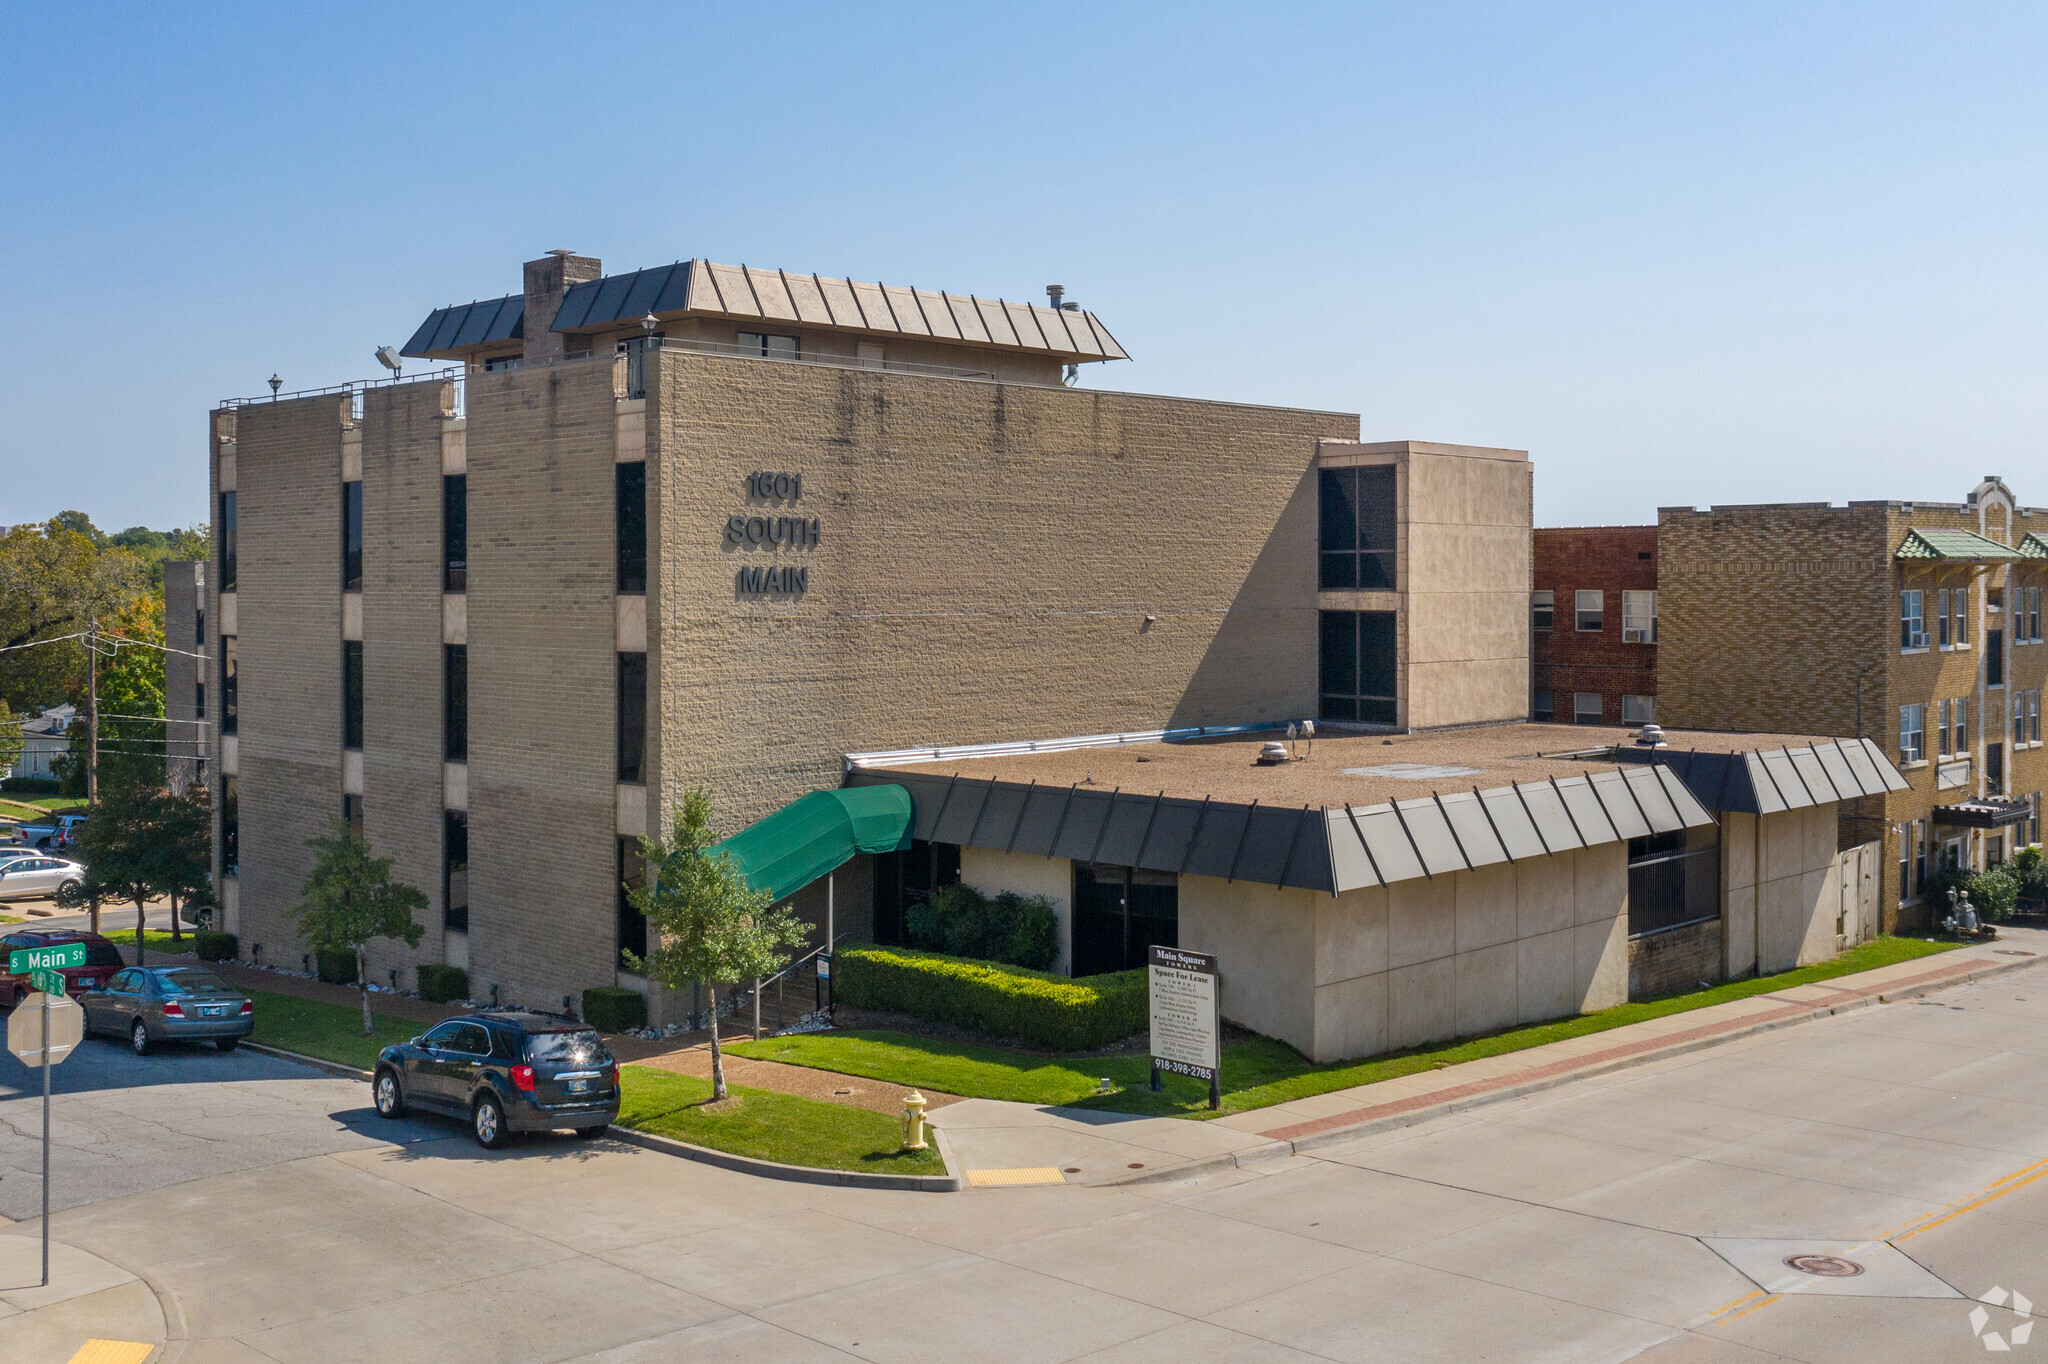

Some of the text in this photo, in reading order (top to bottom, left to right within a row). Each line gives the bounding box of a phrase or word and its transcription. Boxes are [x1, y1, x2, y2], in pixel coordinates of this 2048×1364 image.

[748, 471, 802, 499] 1601
[729, 515, 820, 544] SOUTH
[741, 566, 808, 592] MAIN
[12, 950, 83, 969] S Main St
[1156, 950, 1206, 965] Main Square
[1166, 961, 1197, 970] TOWERS
[1154, 968, 1208, 983] Space For Lease
[1155, 1058, 1212, 1079] 918-398-2785
